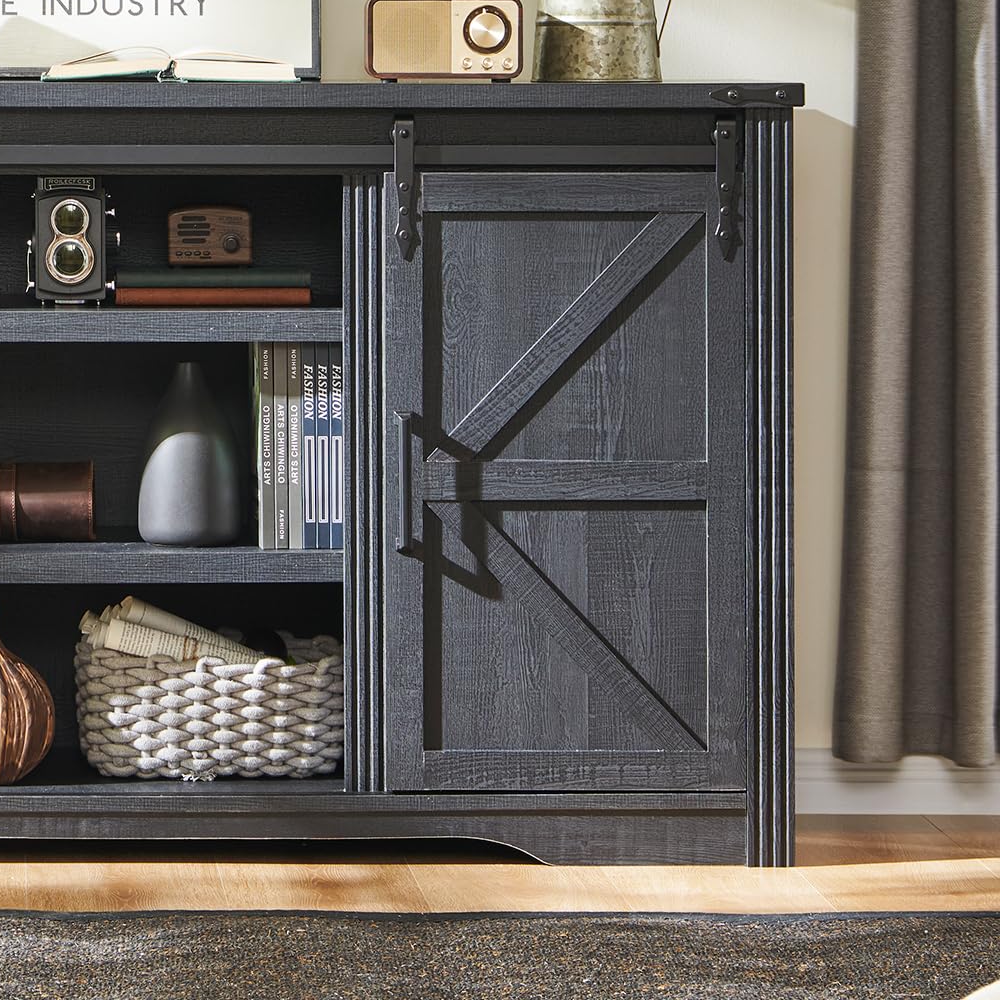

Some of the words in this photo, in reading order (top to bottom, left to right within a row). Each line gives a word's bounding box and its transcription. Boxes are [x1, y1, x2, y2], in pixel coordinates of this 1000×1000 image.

[277, 404, 285, 428] ARTS
[303, 364, 314, 420] FASHION
[317, 364, 328, 420] FASHION
[332, 364, 342, 420] FASHION
[262, 405, 271, 458] CHIWINGLO
[277, 431, 286, 484] CHIWINGLO
[290, 405, 299, 457] CHIWINGLO
[263, 461, 271, 485] ARTS
[290, 460, 299, 485] ARTS
